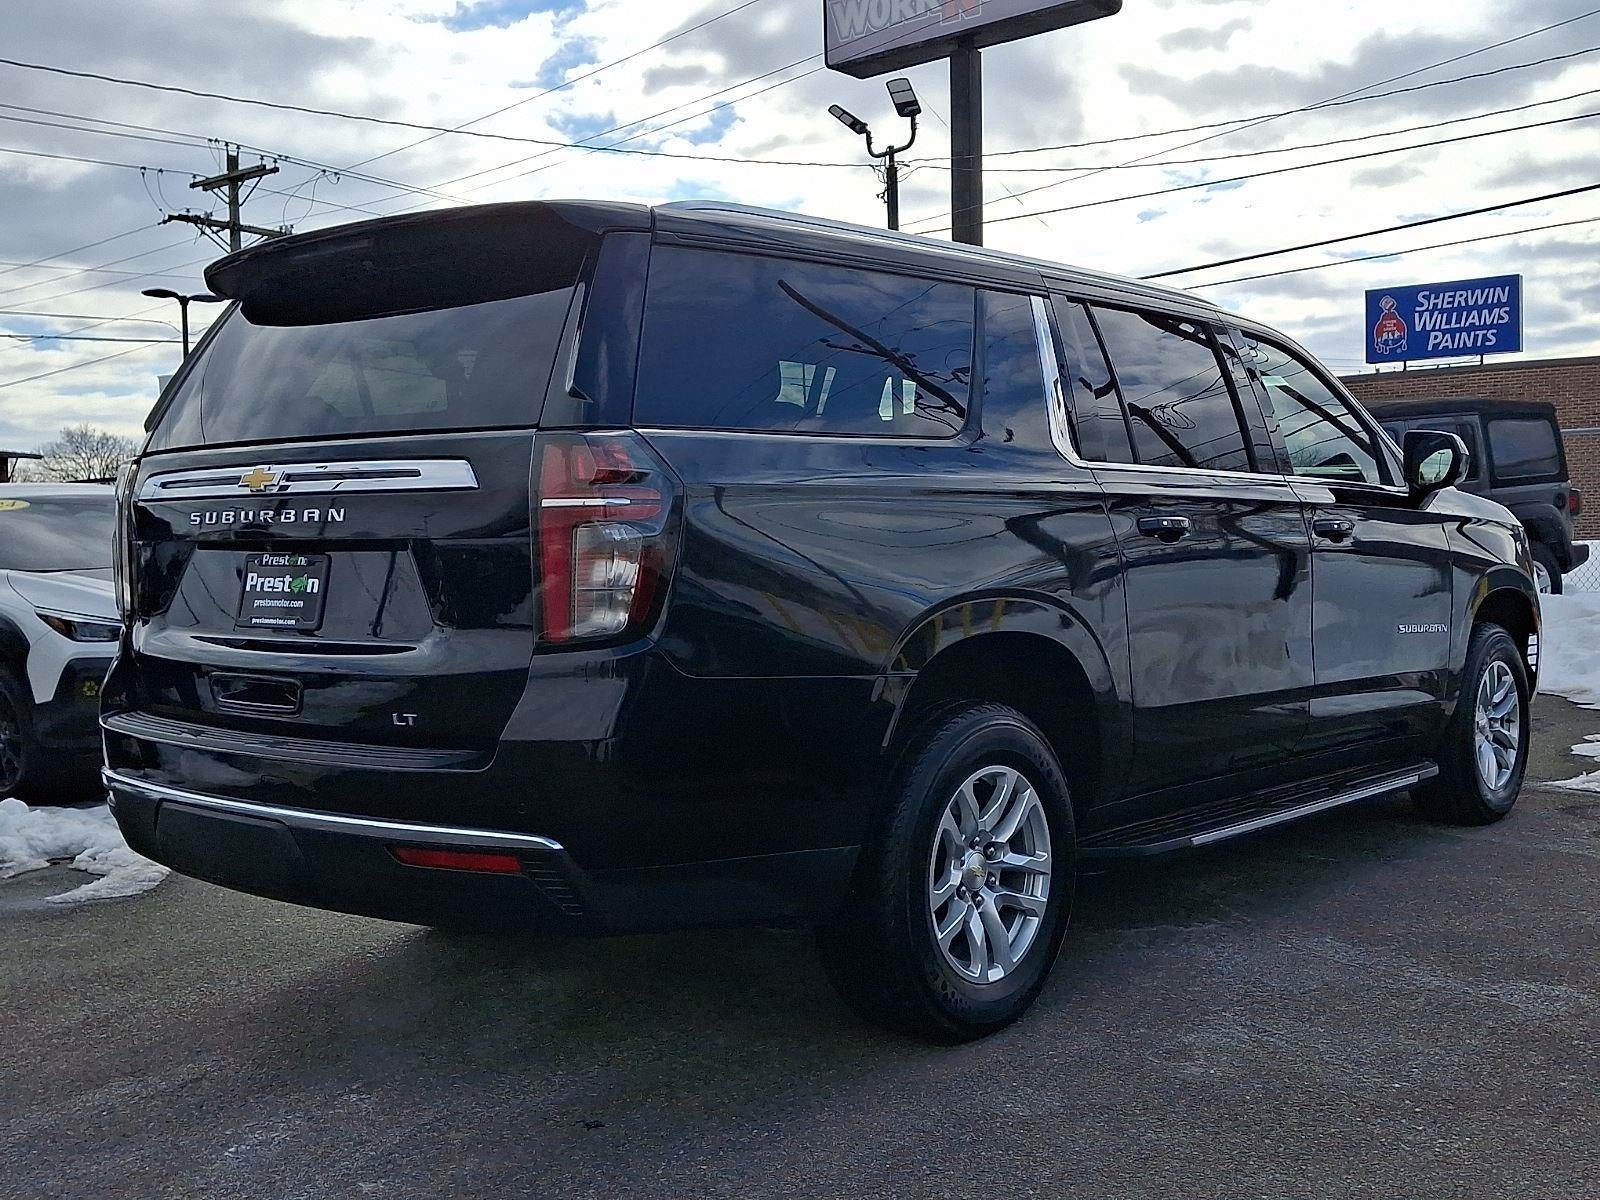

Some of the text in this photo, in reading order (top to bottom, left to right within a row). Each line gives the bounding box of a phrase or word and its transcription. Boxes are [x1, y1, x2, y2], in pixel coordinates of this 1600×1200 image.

[1415, 286, 1510, 311] SHERWIN
[1414, 306, 1511, 332] WILLIAMS
[1427, 329, 1497, 351] PAINTS
[190, 508, 345, 525] SUBURBAN
[253, 598, 304, 608] prestonmotor.com
[1398, 624, 1448, 634] SUBURBAN
[392, 713, 418, 726] LT
